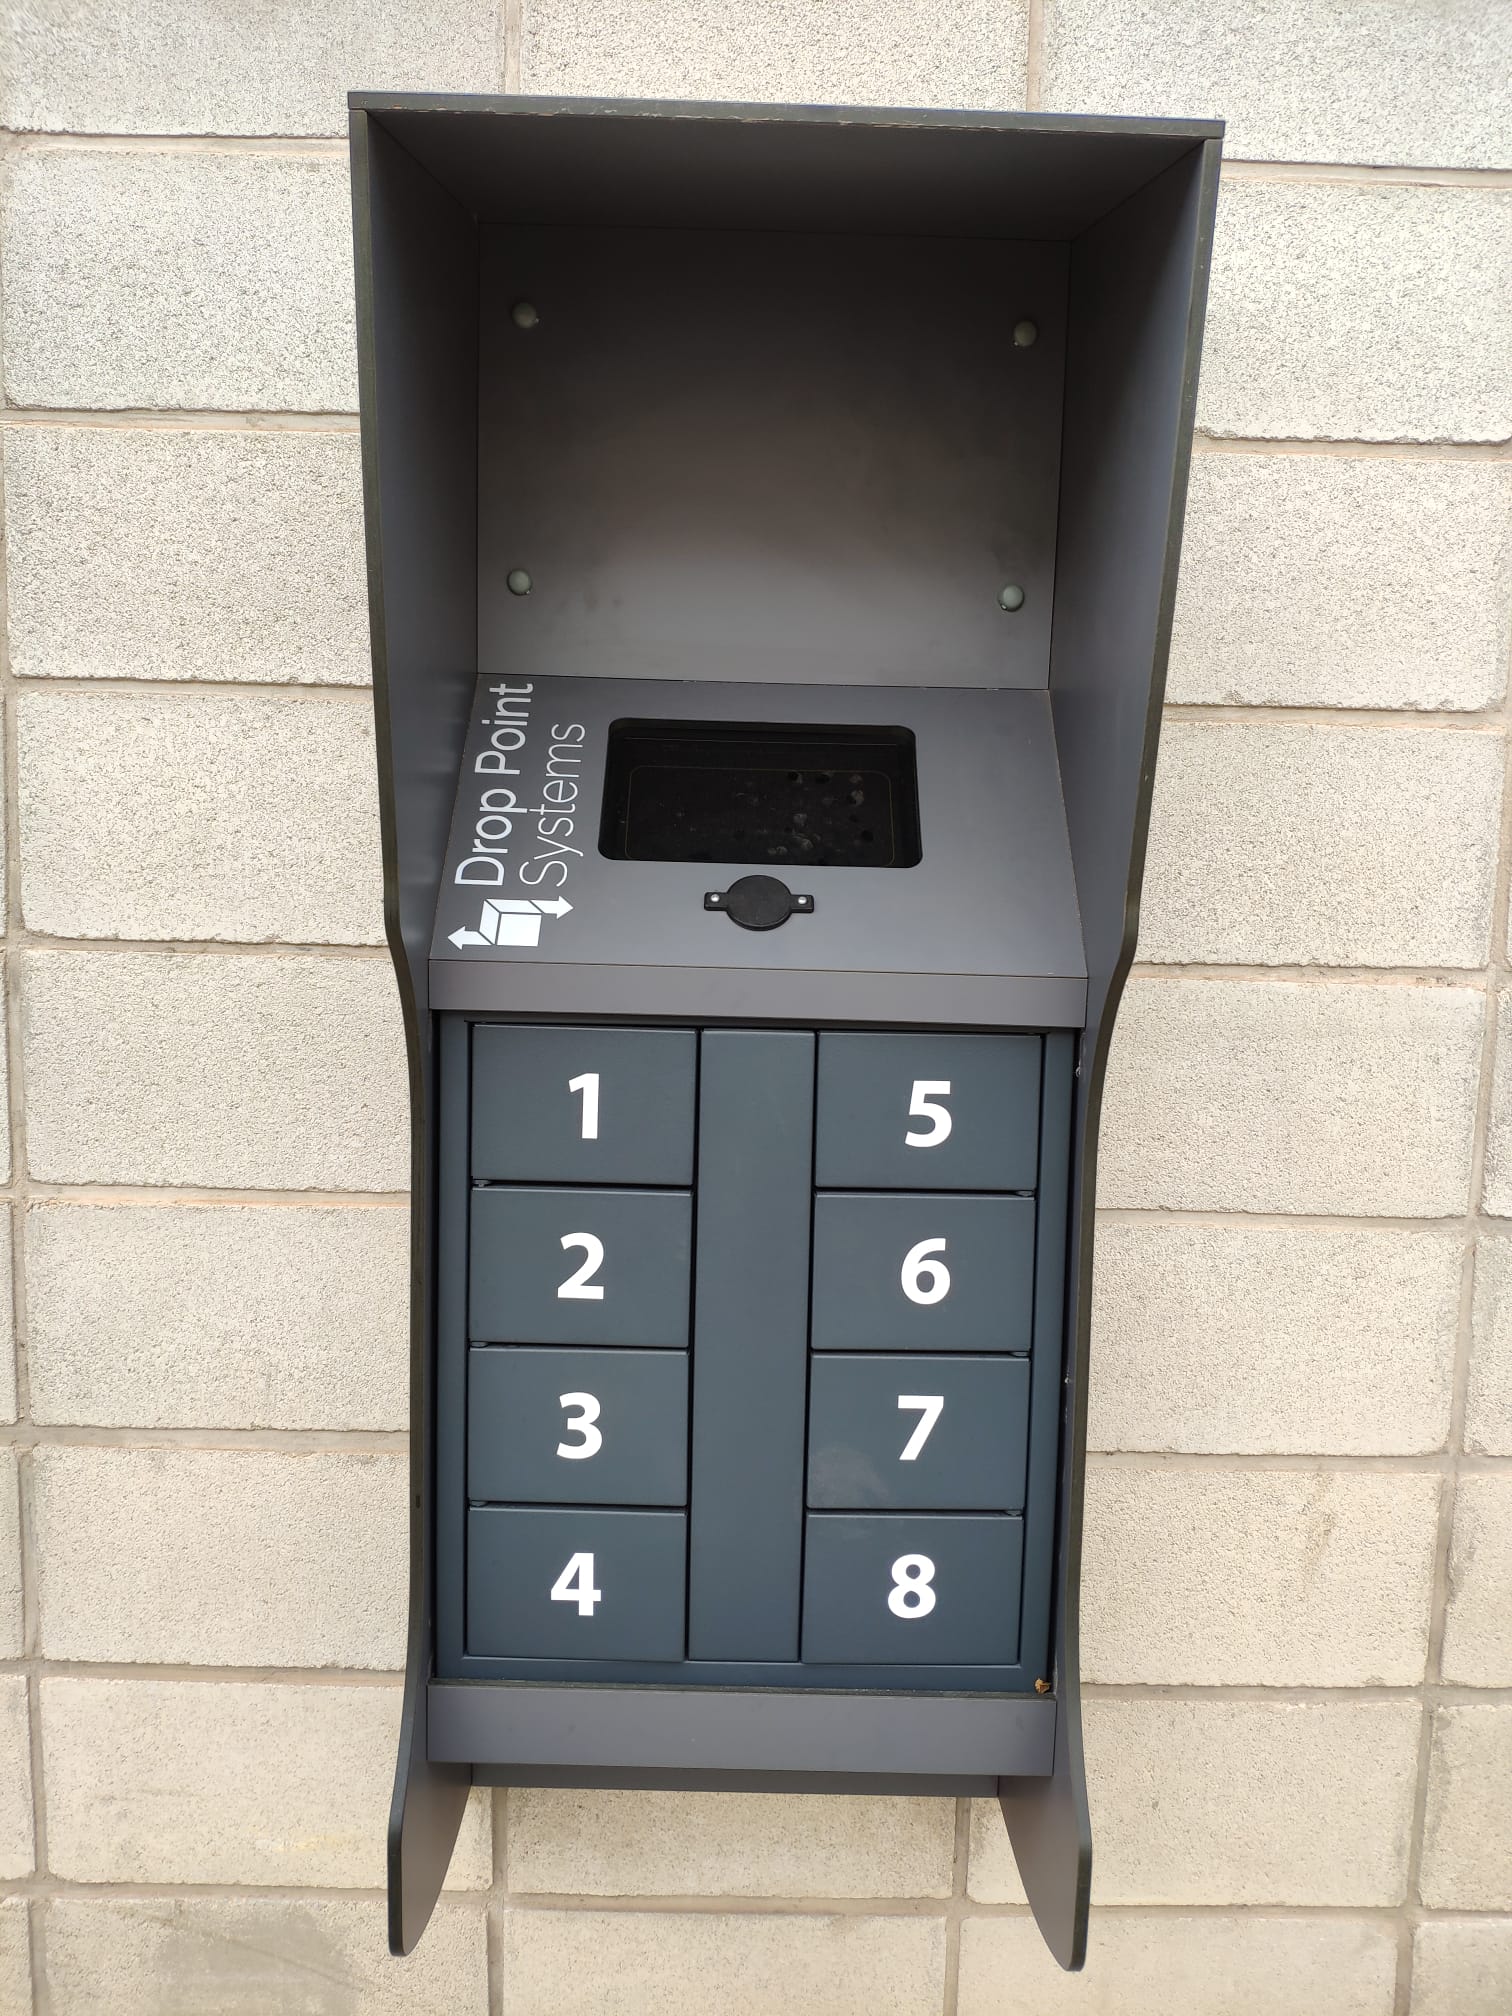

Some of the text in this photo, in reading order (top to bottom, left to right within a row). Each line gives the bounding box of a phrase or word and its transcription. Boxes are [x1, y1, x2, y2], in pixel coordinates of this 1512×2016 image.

[454, 682, 535, 887] Drop Point
[517, 722, 587, 888] Systems
[568, 1072, 601, 1141] 1
[904, 1079, 954, 1149] 5
[556, 1232, 606, 1301] 2
[899, 1236, 952, 1306] 6
[555, 1390, 604, 1461] 3
[896, 1394, 946, 1463] 7
[549, 1551, 603, 1618] 4
[886, 1552, 938, 1620] 8
